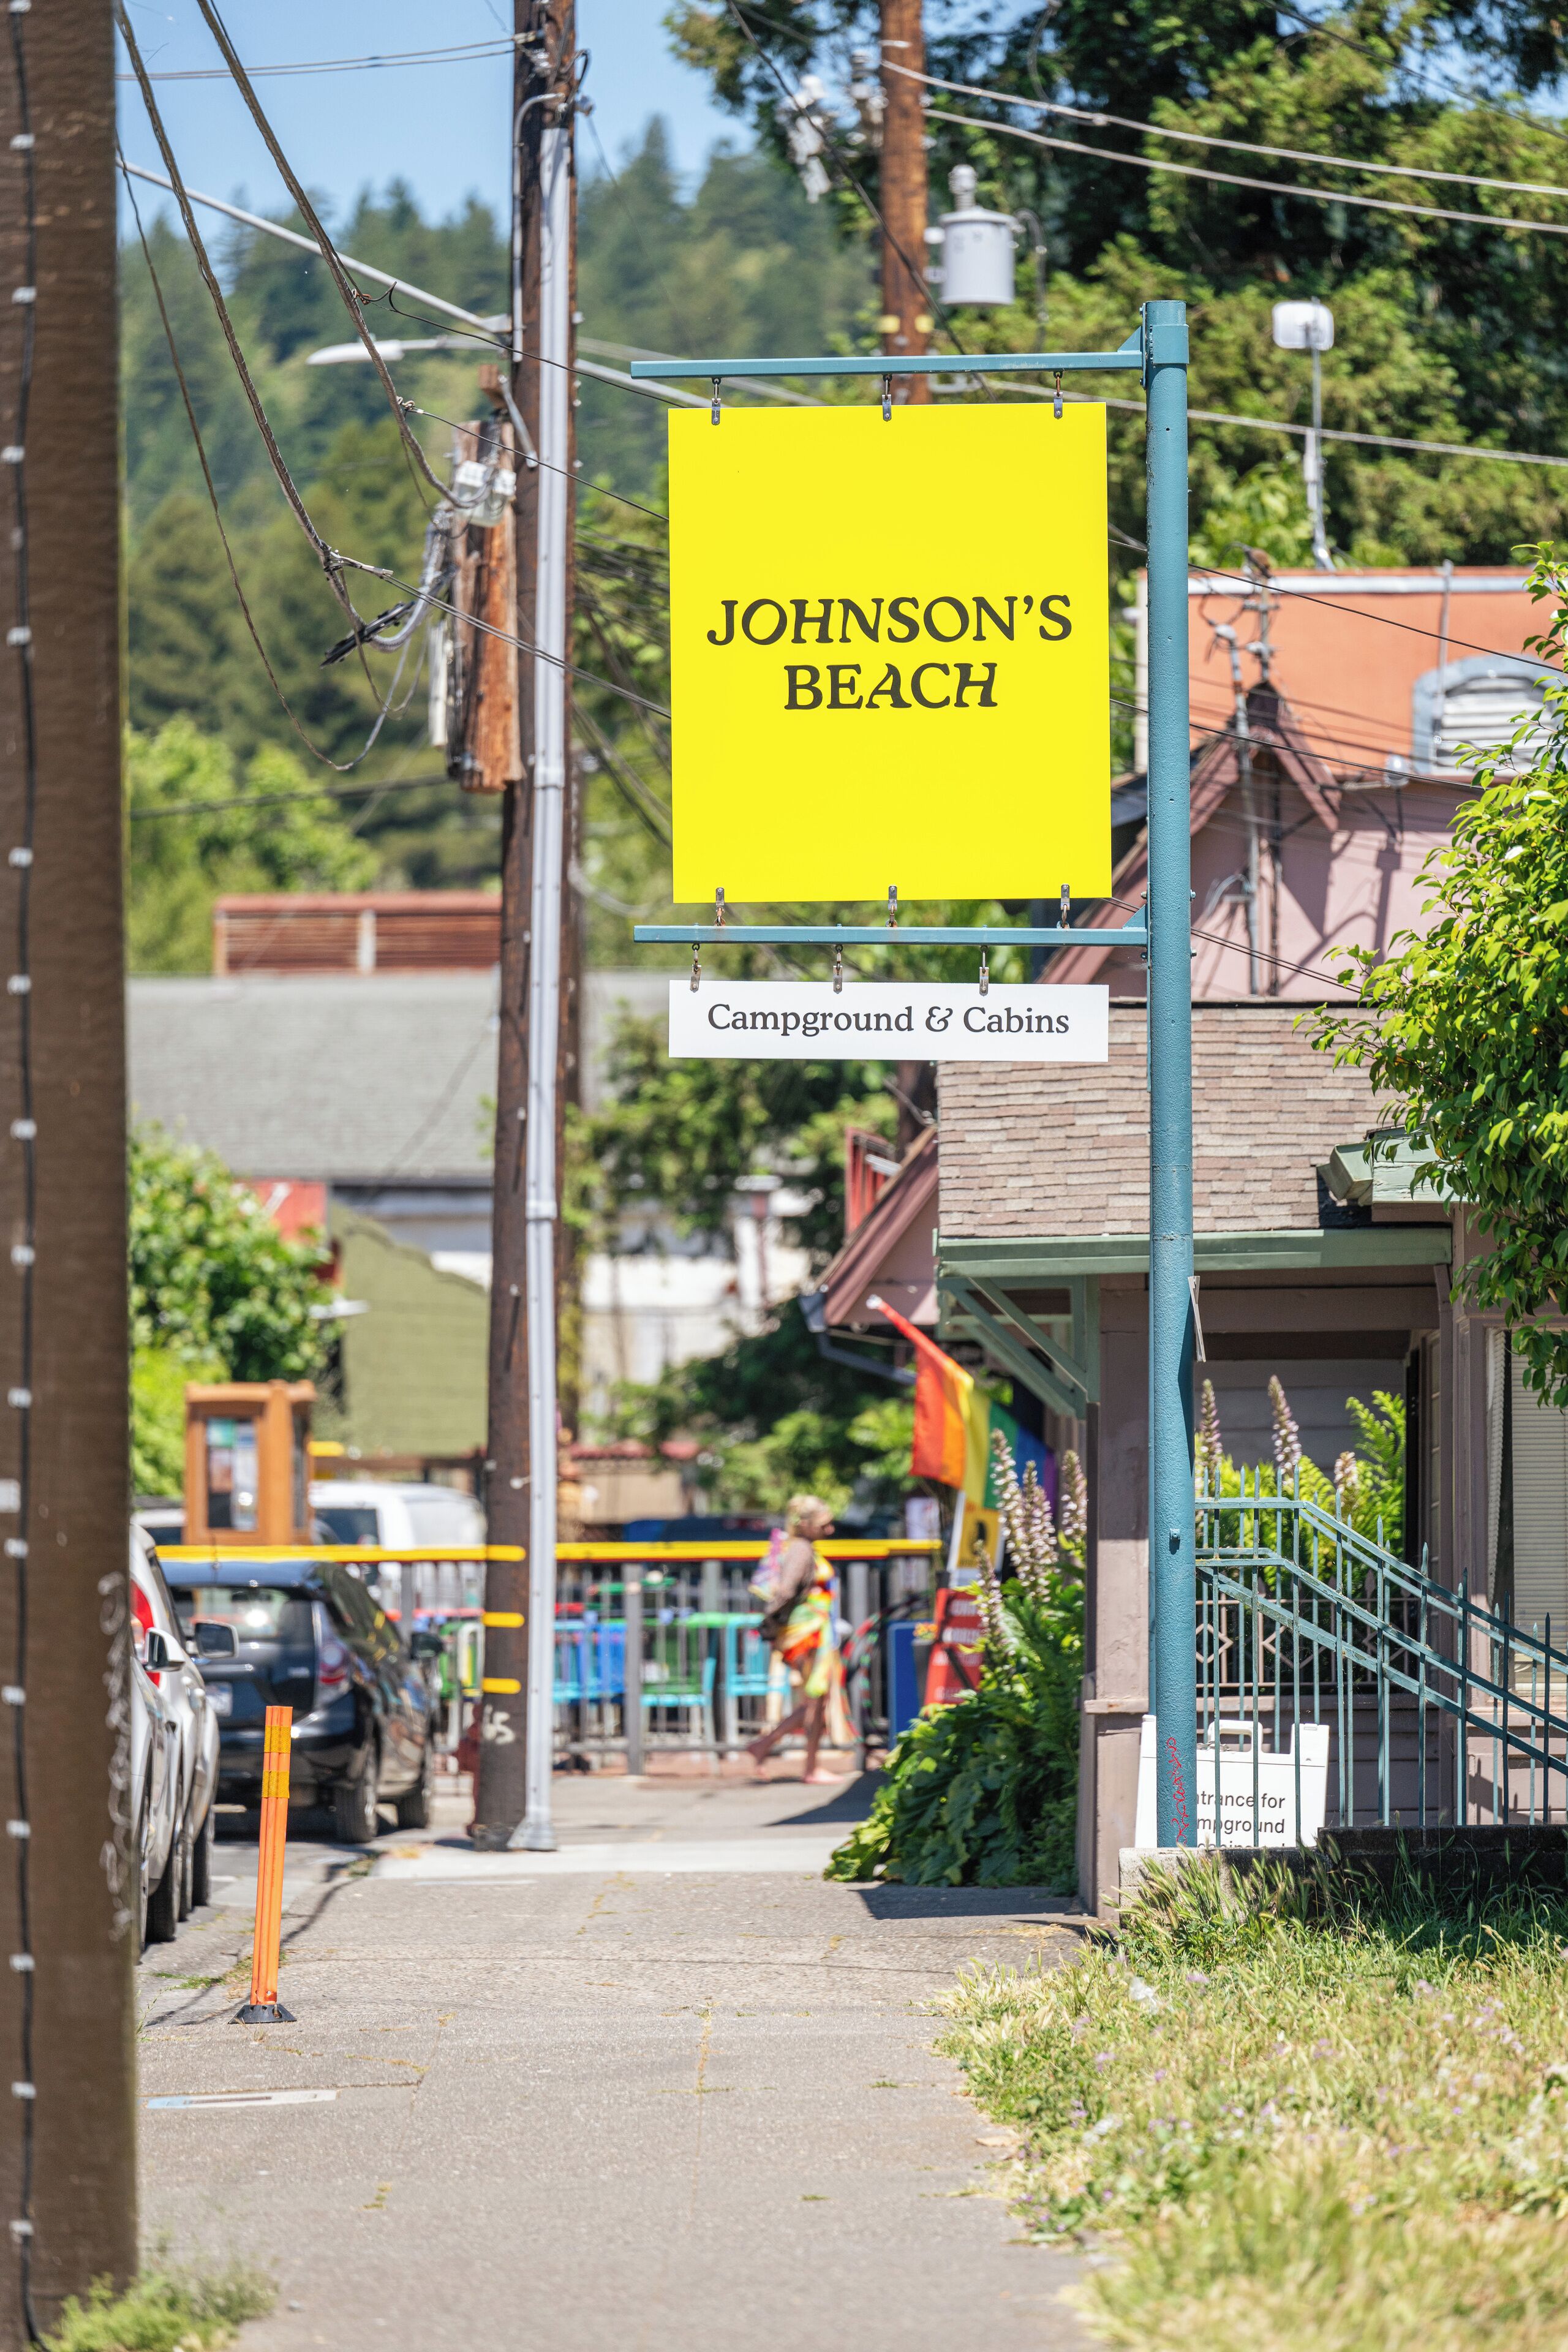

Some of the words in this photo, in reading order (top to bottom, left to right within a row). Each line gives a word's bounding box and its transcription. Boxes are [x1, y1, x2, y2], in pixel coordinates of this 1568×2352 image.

[707, 595, 1071, 646] JOHNSON'S
[784, 663, 997, 709] BEACH
[708, 1004, 914, 1036] Campground
[925, 1006, 952, 1032] &
[963, 1007, 1069, 1033] Cabins
[1197, 1791, 1254, 1807] trance
[1261, 1793, 1286, 1809] for
[1197, 1818, 1285, 1835] mpground
